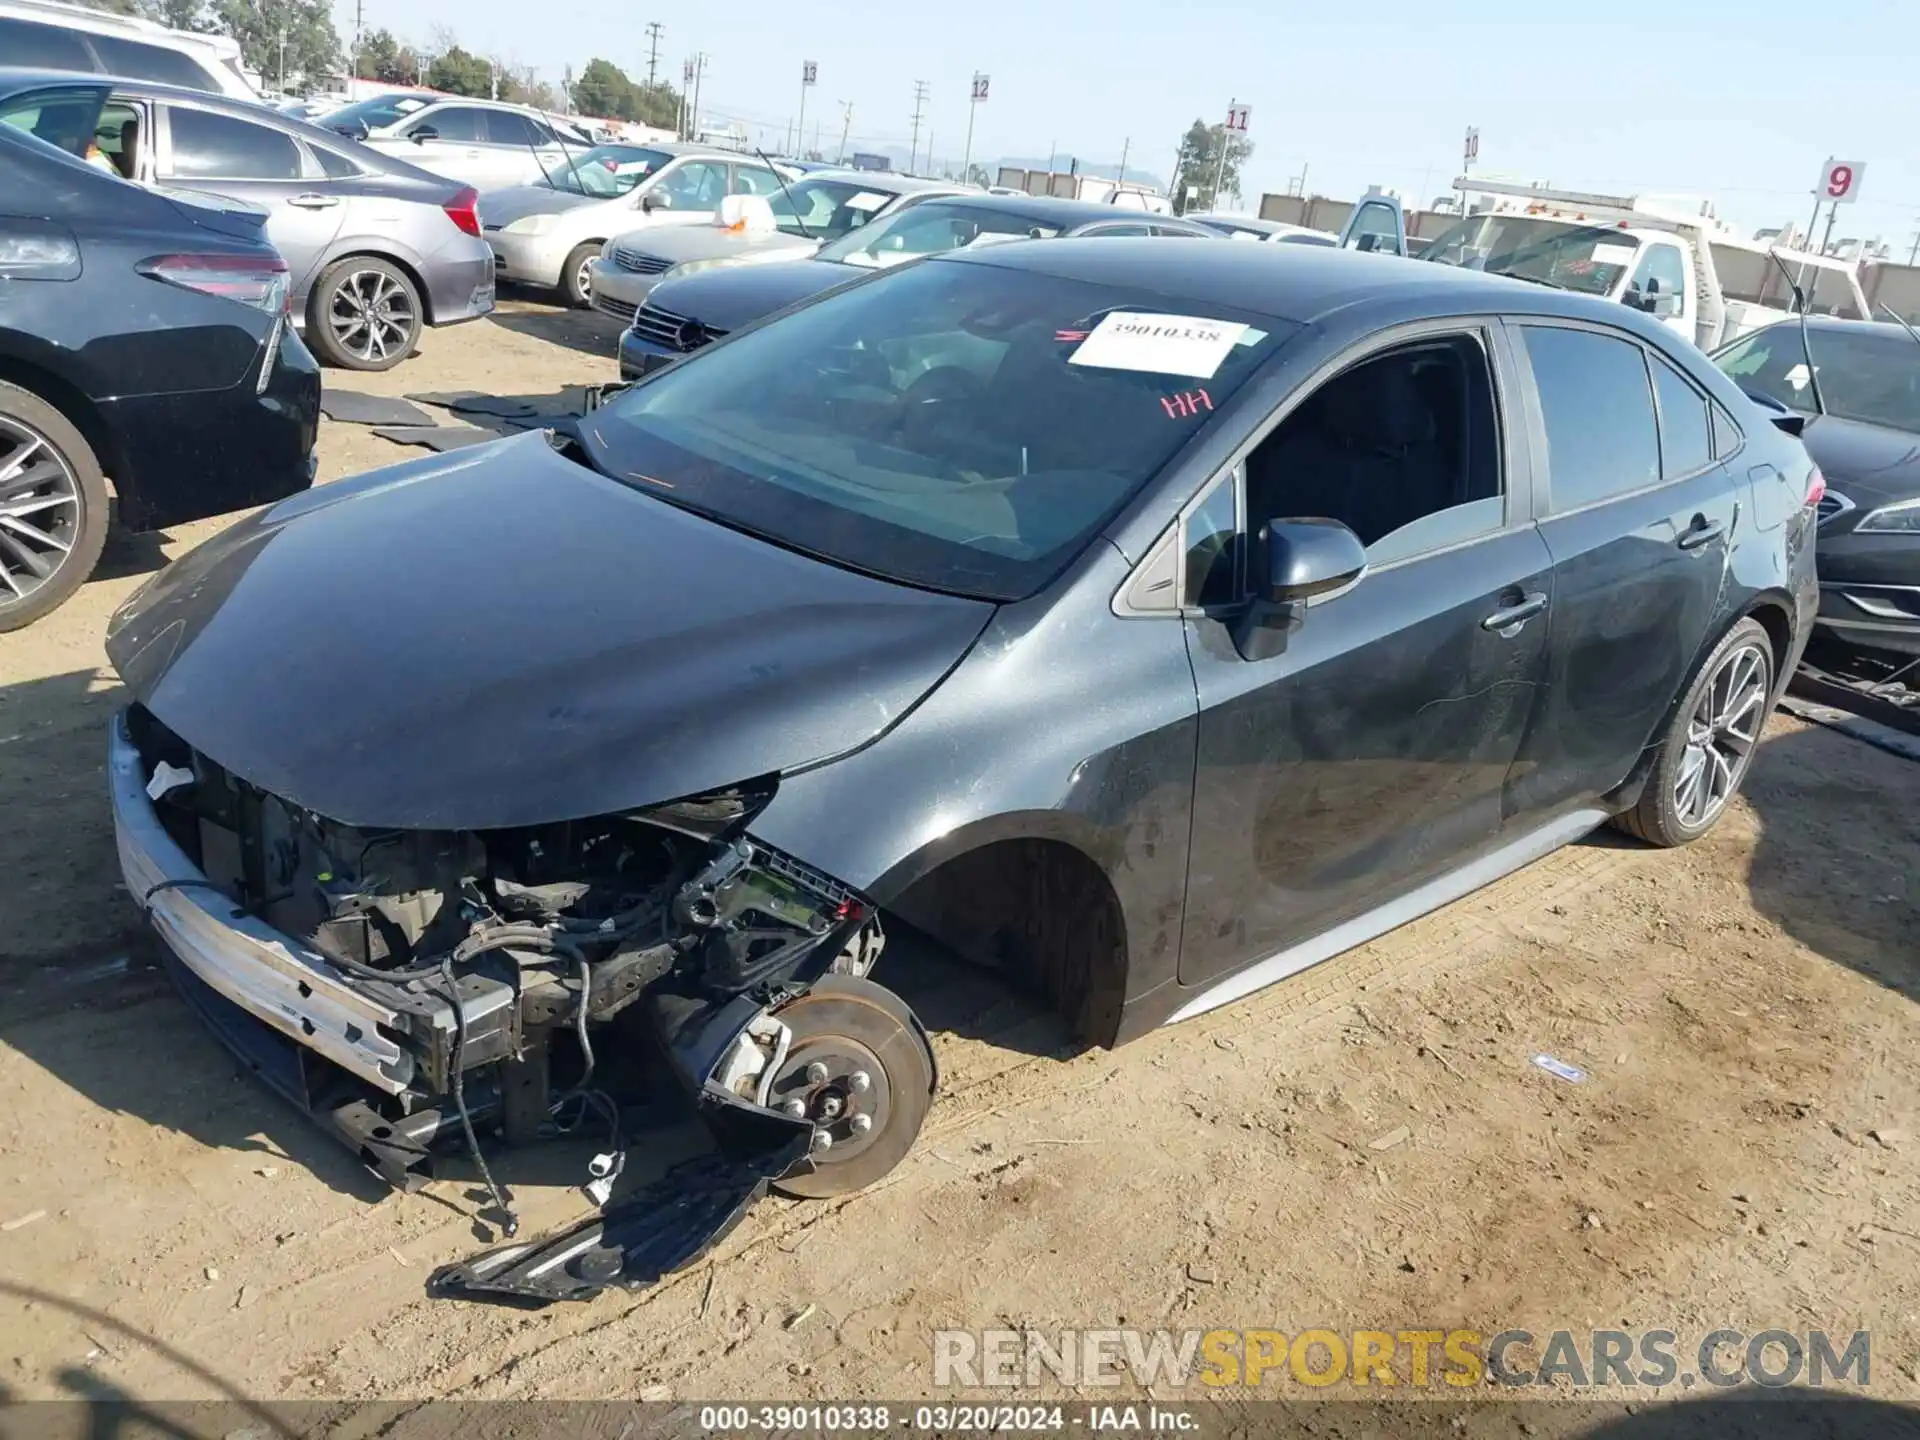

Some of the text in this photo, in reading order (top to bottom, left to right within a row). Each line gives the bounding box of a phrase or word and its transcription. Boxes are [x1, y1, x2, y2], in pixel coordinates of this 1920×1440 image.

[803, 66, 817, 82] 13
[971, 79, 989, 98] 12
[1225, 109, 1247, 130] 11
[1464, 135, 1479, 159] 10
[1827, 165, 1853, 197] 9
[1112, 322, 1221, 342] 39010338
